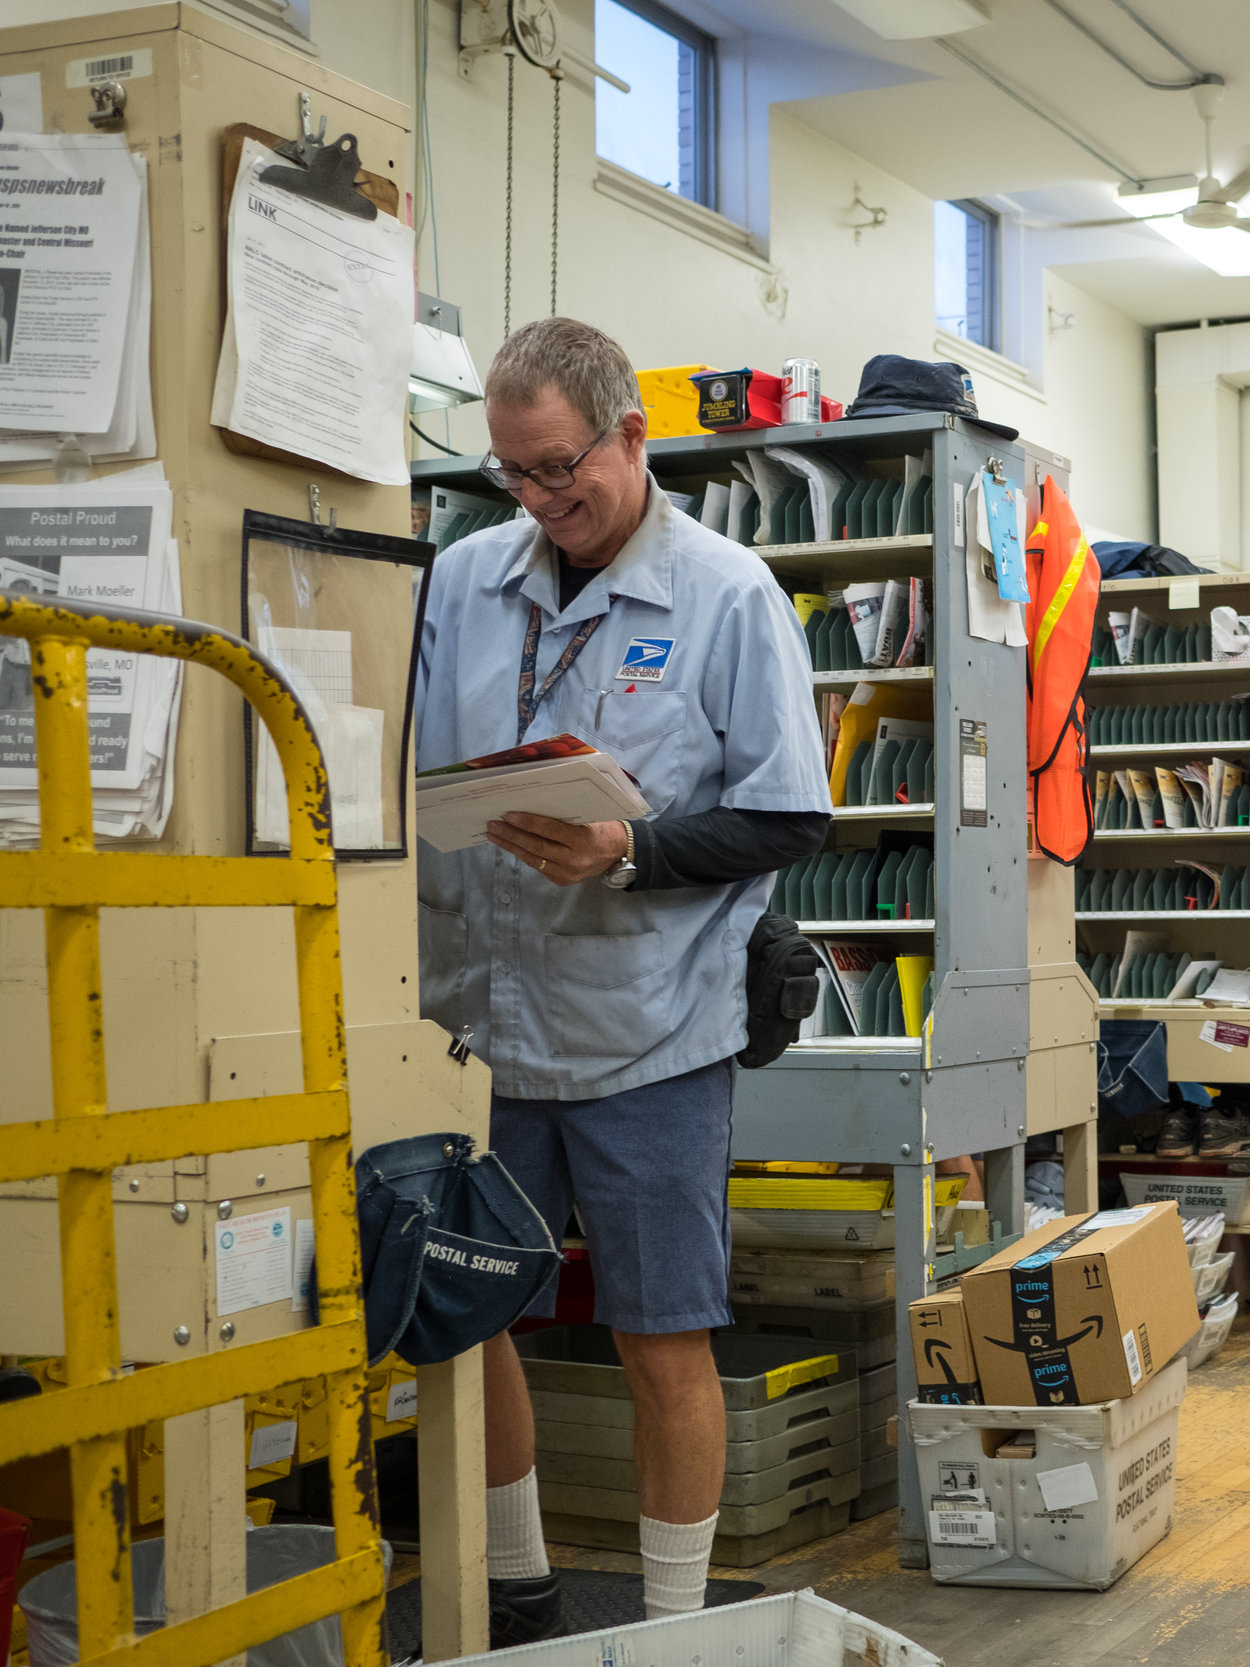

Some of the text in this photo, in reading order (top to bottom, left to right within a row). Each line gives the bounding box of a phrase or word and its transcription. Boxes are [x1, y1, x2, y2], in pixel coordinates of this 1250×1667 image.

[248, 196, 278, 222] LINK
[707, 409, 730, 419] TOWER
[30, 511, 117, 525] Postal Proud
[4, 535, 138, 549] What does it mean to you?
[67, 585, 135, 597] Mark Moeller
[115, 659, 133, 670] MO
[18, 733, 33, 744] I'm
[98, 736, 128, 749] ready
[3, 752, 31, 762] serve
[1148, 1183, 1223, 1195] UNITED STATES
[1185, 1197, 1227, 1207] SERVICE
[423, 1241, 520, 1276] POSTAL SERVICE
[814, 1288, 843, 1297] LABEL
[1016, 1280, 1049, 1294] prime
[1034, 1363, 1067, 1379] prime
[1118, 1437, 1171, 1492] UNITED STATES
[1115, 1462, 1173, 1524] POSTAL SERVICE
